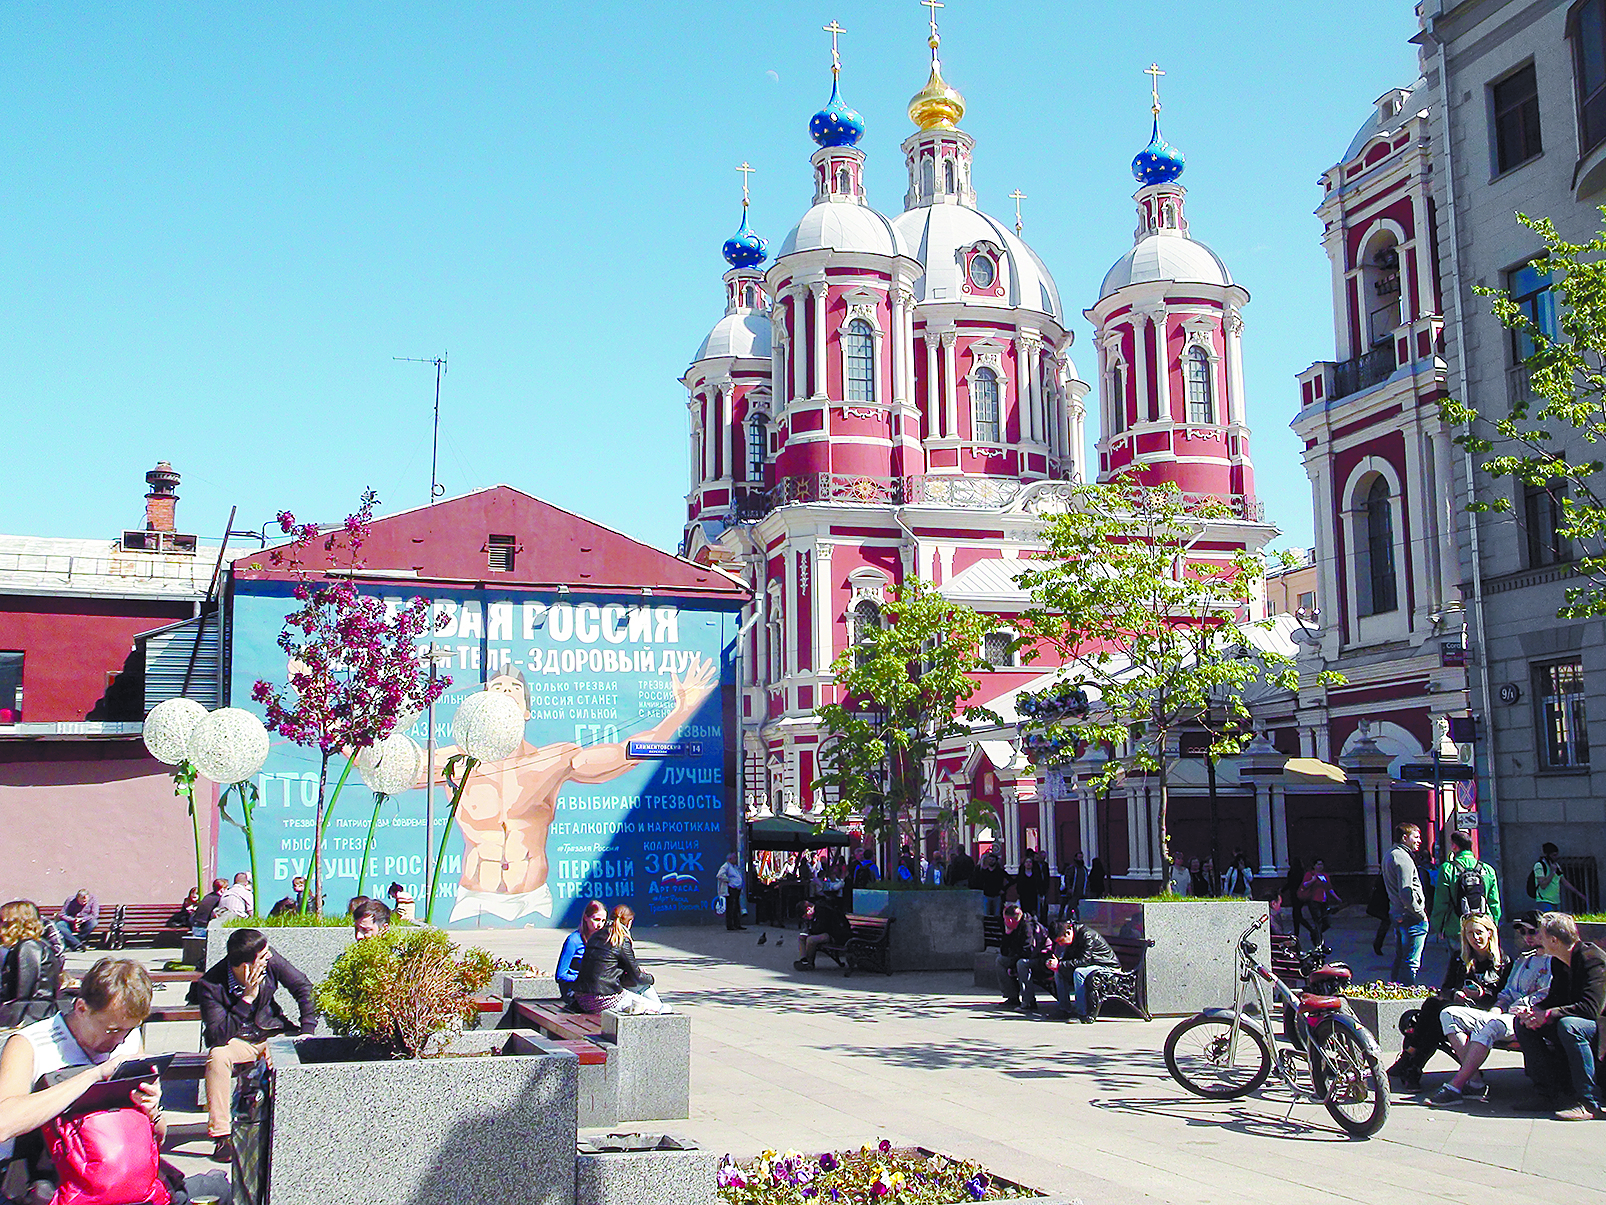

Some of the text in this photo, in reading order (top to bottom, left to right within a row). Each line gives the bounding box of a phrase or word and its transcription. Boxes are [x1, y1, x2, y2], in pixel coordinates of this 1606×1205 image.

[522, 600, 679, 643] РОССИЯ
[527, 646, 655, 675] ЗДОРОВЫЙ
[658, 650, 702, 675] ДУХ
[529, 681, 618, 692] ТОЛЬКО ТРЕЗВАЯ
[639, 680, 673, 690] ТРЕЗВАЯ
[530, 694, 618, 706] РОССИЯ СТАНЕТ
[639, 691, 675, 701] РОССИЯ
[530, 707, 618, 719] САМОЙ СИЛЬНОЙ
[639, 709, 645, 718] С
[574, 723, 620, 746] ГТО
[692, 745, 701, 753] 14
[662, 767, 722, 784] ЛУЧШЕ
[258, 772, 320, 808] ГТО
[557, 795, 722, 810] Я ВЫБИРАЮ ТРЕЗВОСТЬ
[336, 818, 389, 828] ПАТРИОТЗМ
[550, 821, 721, 835] НЕТ АЛКОГОЛЮ И НАРКОТИКАМ
[644, 839, 700, 851] КОАЛИЦИЯ
[274, 857, 379, 880] БУУЩЕ
[558, 857, 635, 879] ПЕРВЫЙ
[644, 852, 705, 874] ЗОЖ
[557, 878, 635, 899] ТРЕЗВЫЙ!
